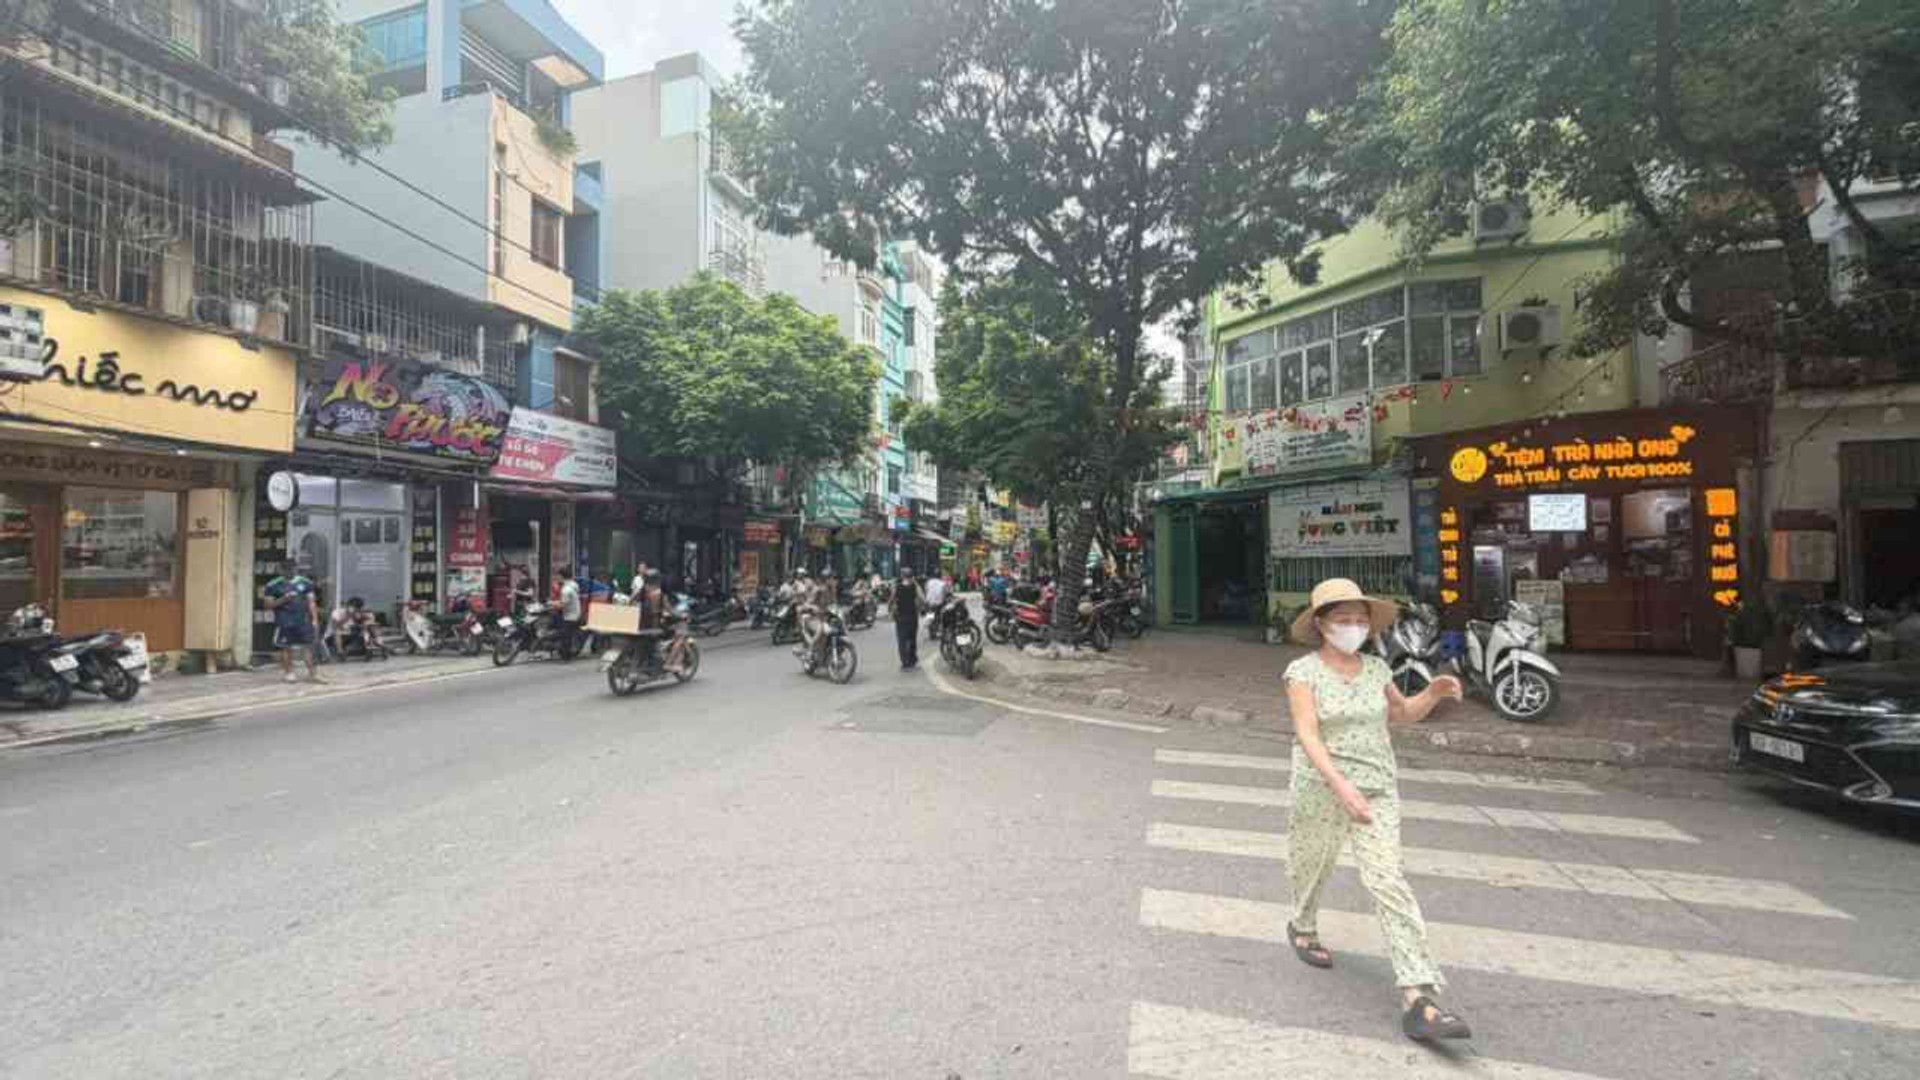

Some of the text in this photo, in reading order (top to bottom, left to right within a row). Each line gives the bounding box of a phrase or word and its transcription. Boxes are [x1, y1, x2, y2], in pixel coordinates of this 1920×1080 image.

[42, 338, 258, 412] hiếc mơ
[1553, 437, 1591, 462] TRÀ
[1594, 435, 1633, 460] NHÀ
[1638, 439, 1680, 458] ONG
[1567, 462, 1601, 481] CÂY
[1647, 460, 1693, 477] 100%
